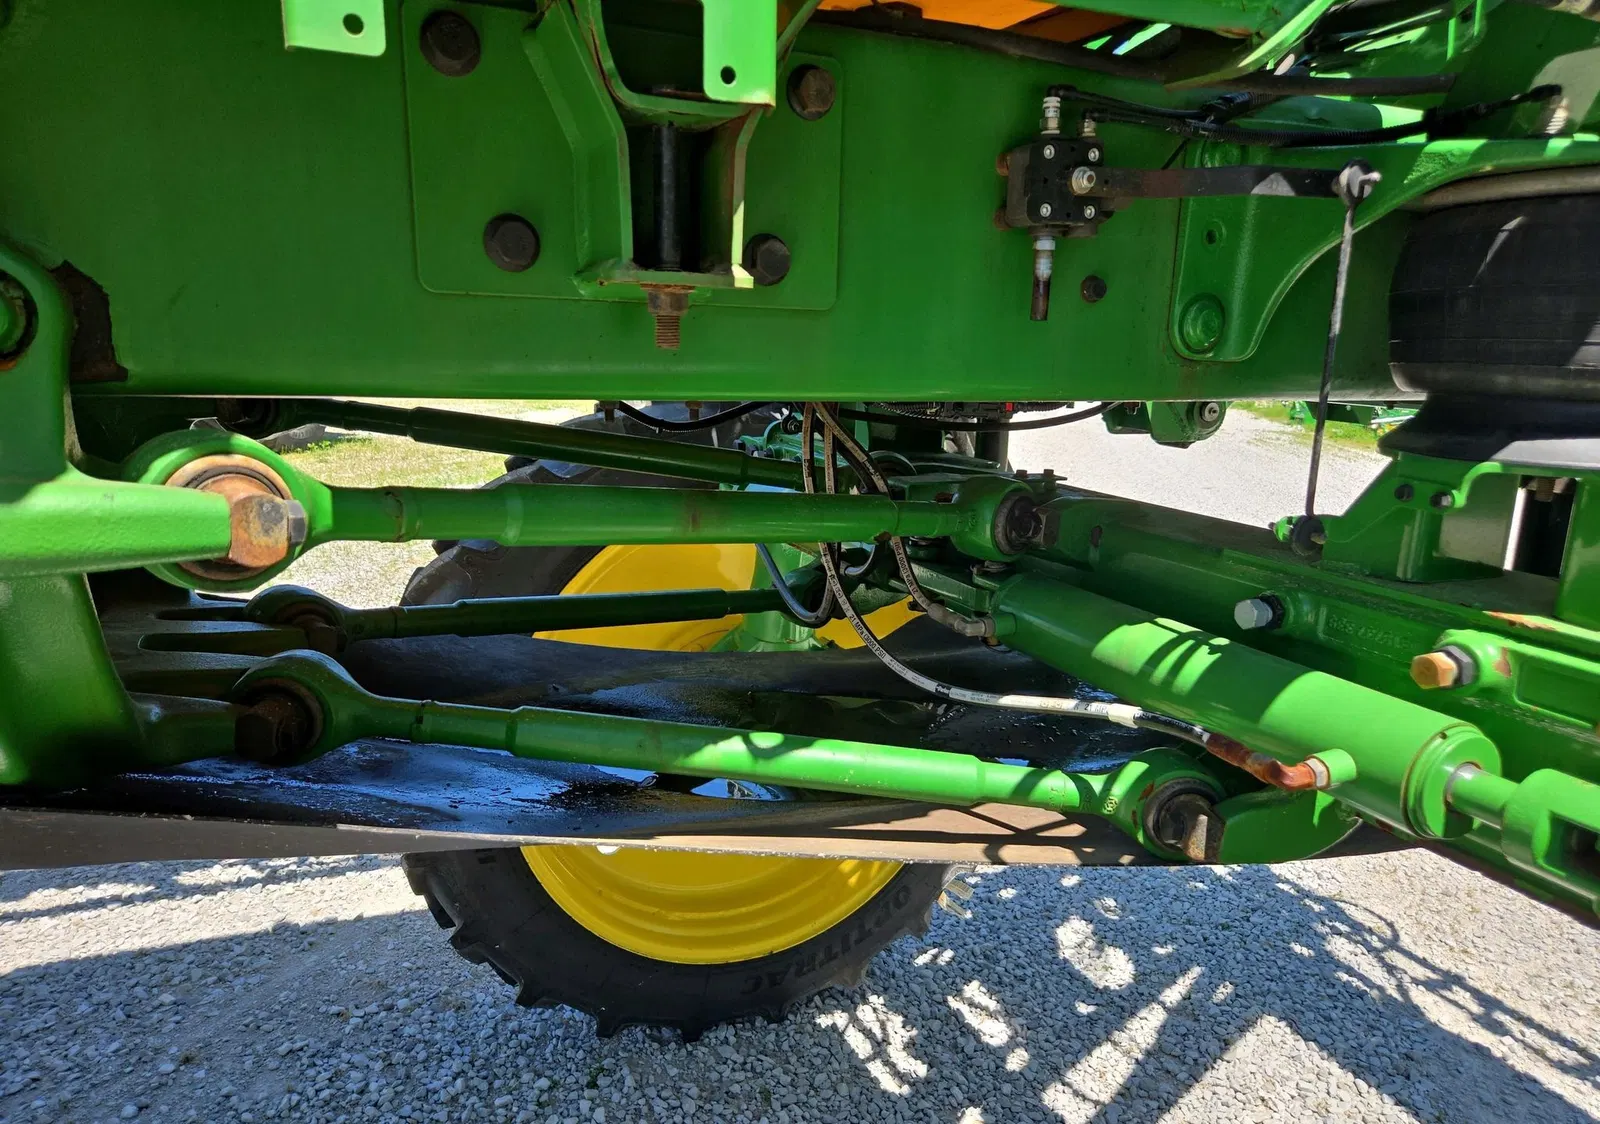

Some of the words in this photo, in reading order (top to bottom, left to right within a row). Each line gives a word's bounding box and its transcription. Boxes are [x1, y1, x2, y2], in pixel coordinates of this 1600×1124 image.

[855, 621, 865, 635] MPa
[863, 634, 877, 649] (3000
[741, 885, 911, 994] OPTITRAC
